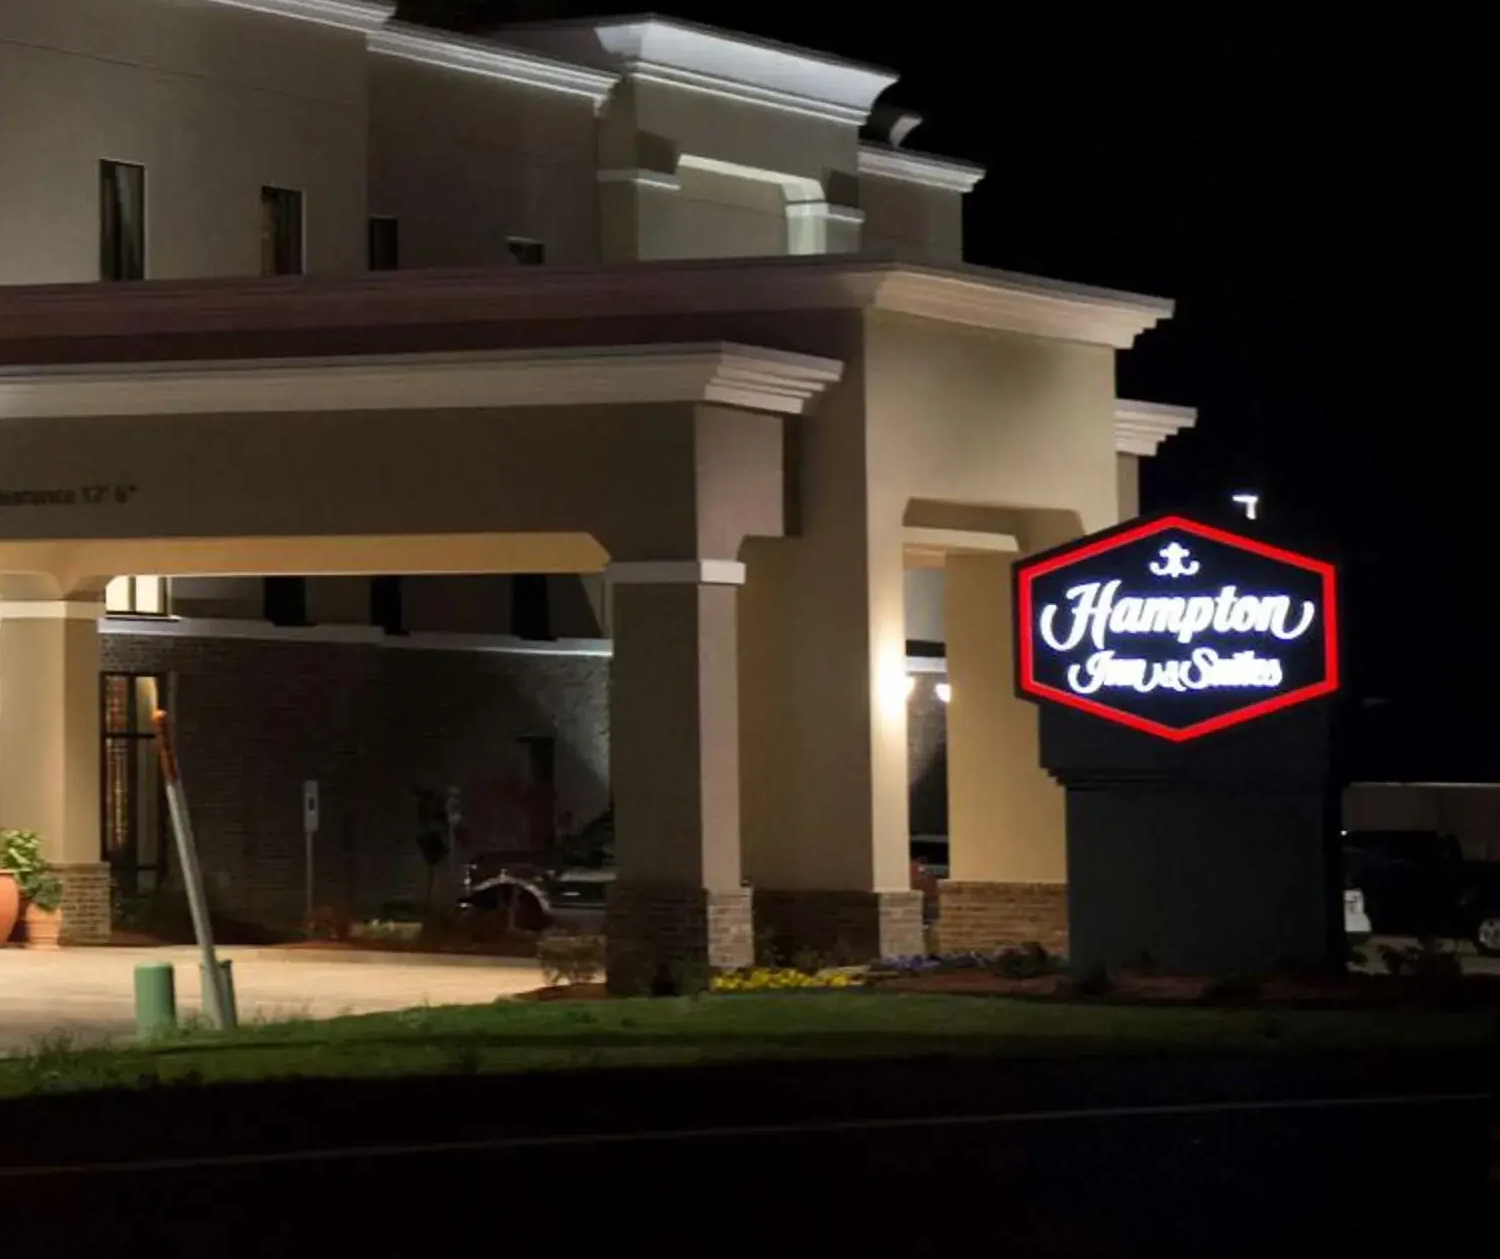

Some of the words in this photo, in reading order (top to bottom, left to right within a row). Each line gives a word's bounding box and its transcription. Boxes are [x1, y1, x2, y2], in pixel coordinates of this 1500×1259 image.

[1039, 579, 1315, 652] Hampton
[1067, 650, 1162, 694] Inn
[1182, 647, 1283, 690] Suites
